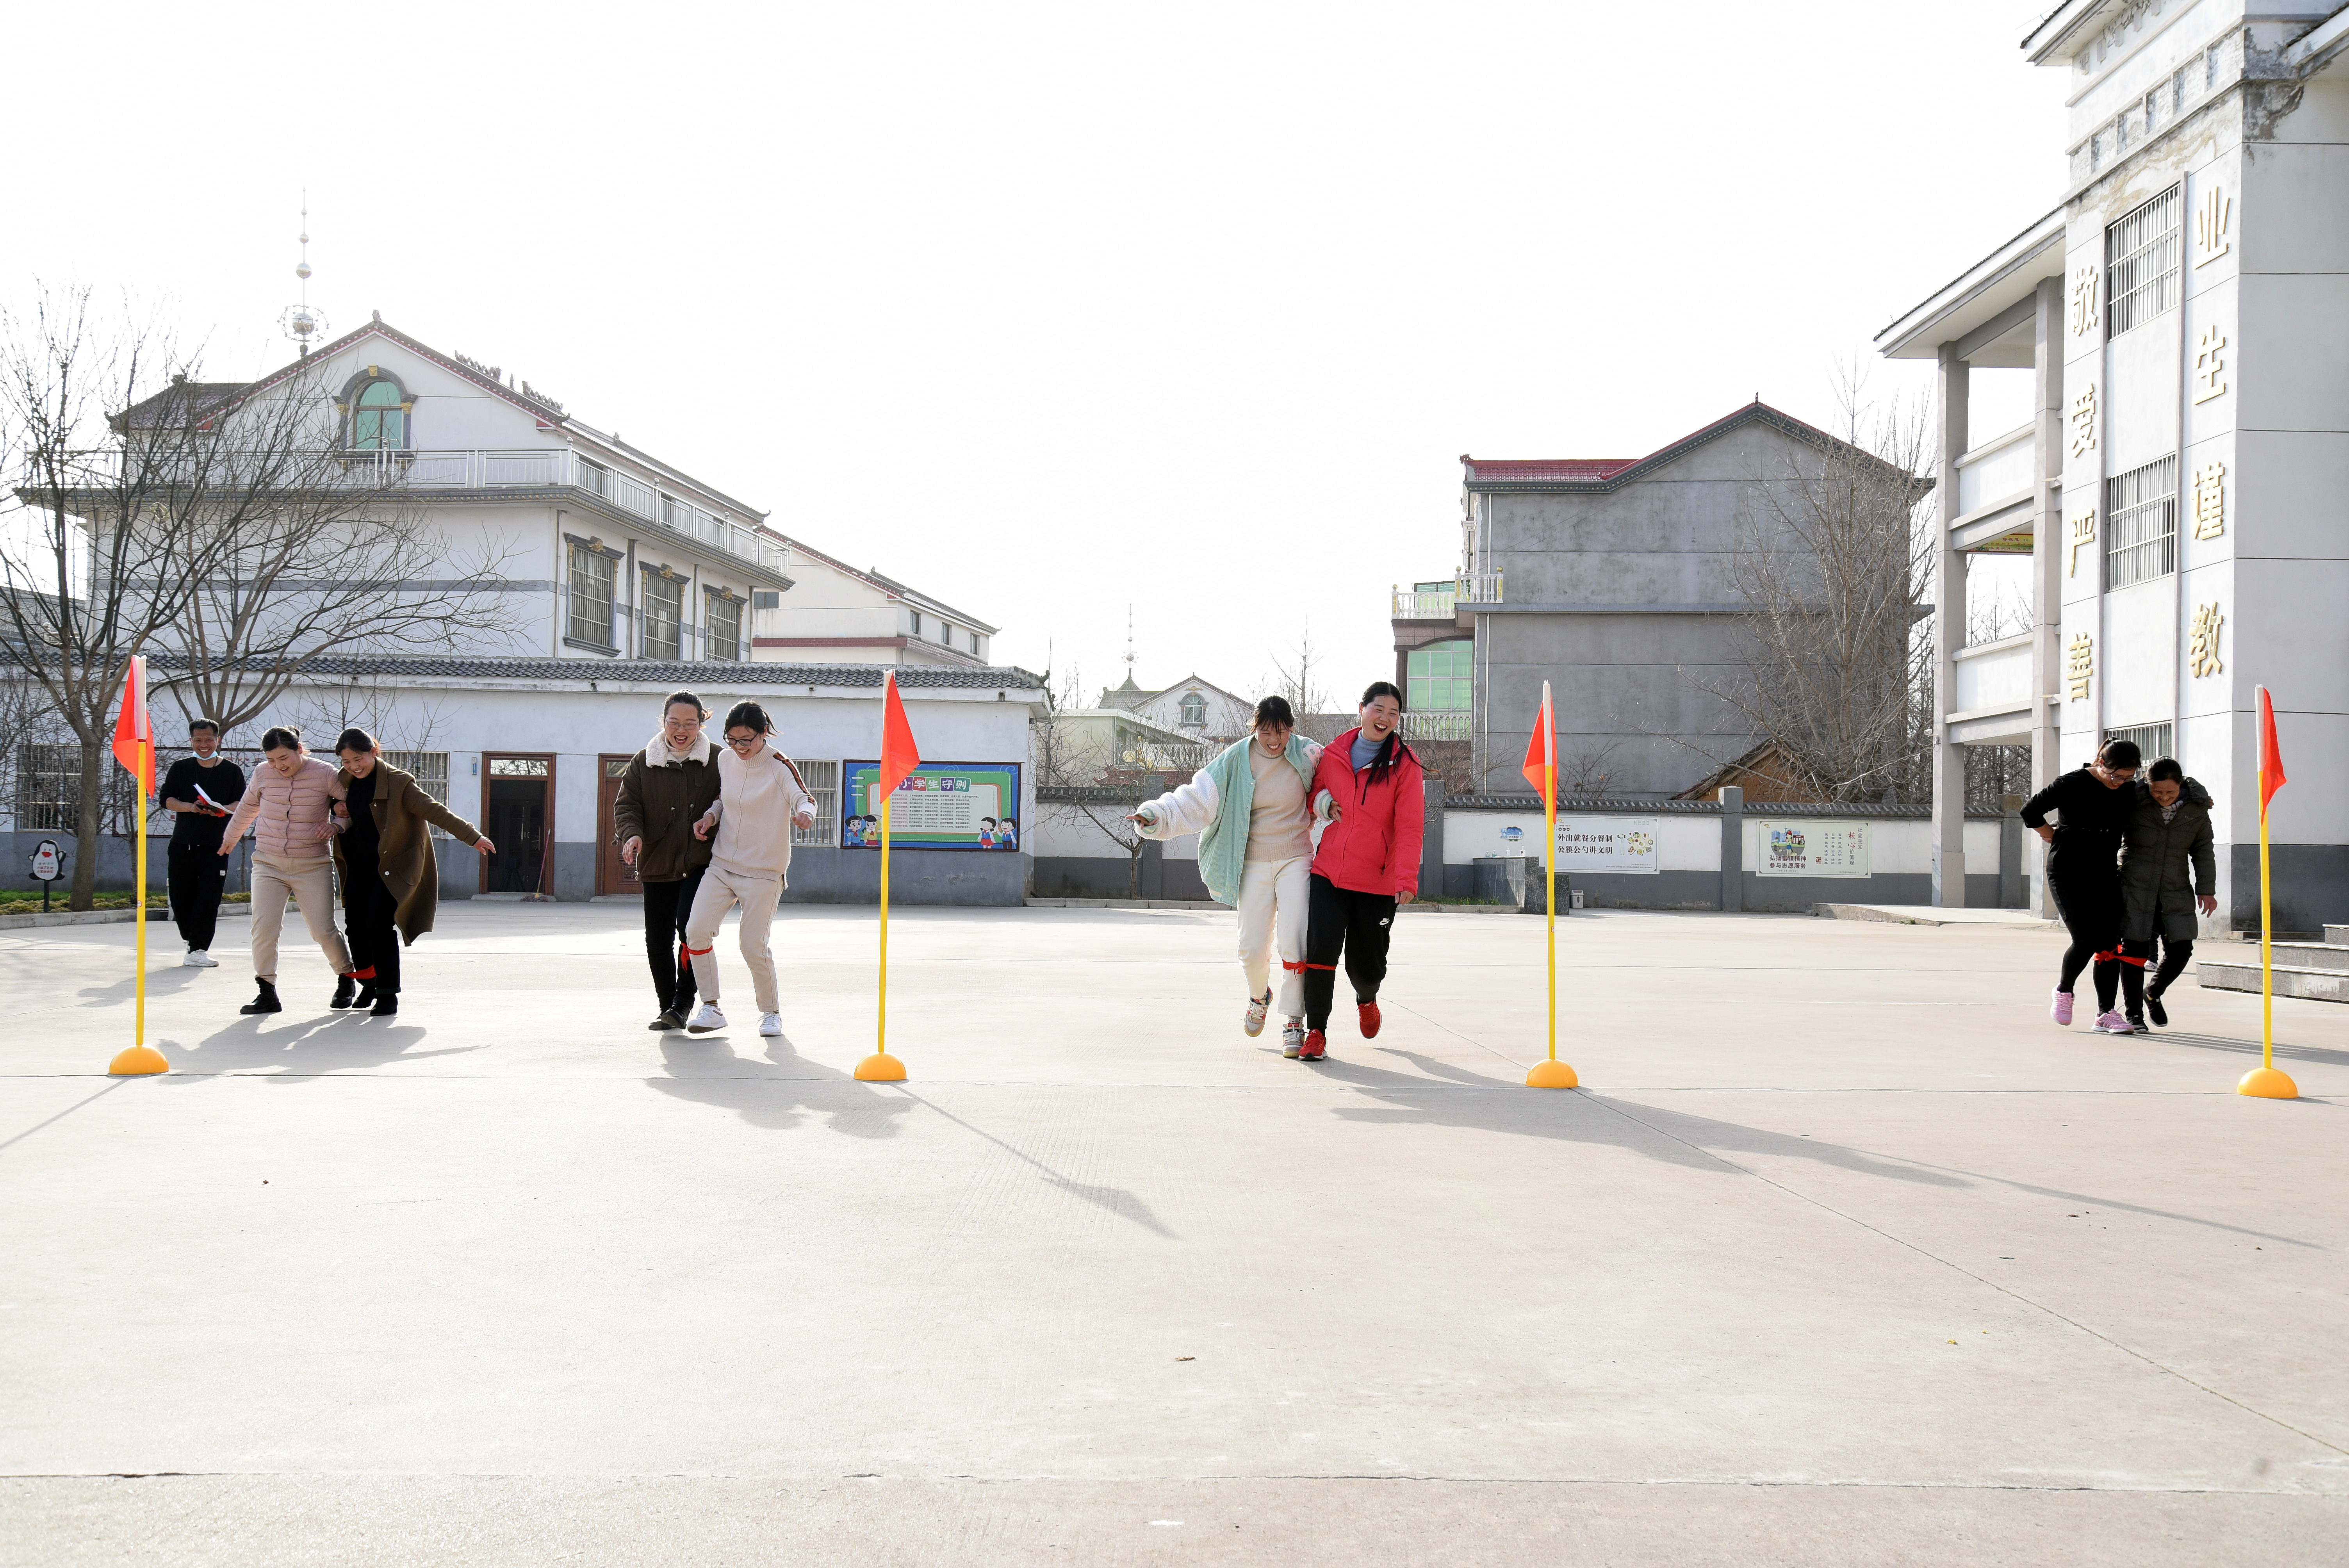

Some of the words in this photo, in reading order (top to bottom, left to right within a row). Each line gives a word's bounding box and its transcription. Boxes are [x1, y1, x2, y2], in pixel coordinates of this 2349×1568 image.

[900, 779, 967, 790] 小学生守则
[1558, 834, 1613, 843] 外出就餐分餐制
[1558, 845, 1613, 854] 公筷公勺讲文明
[1847, 831, 1856, 866] 核心价值观
